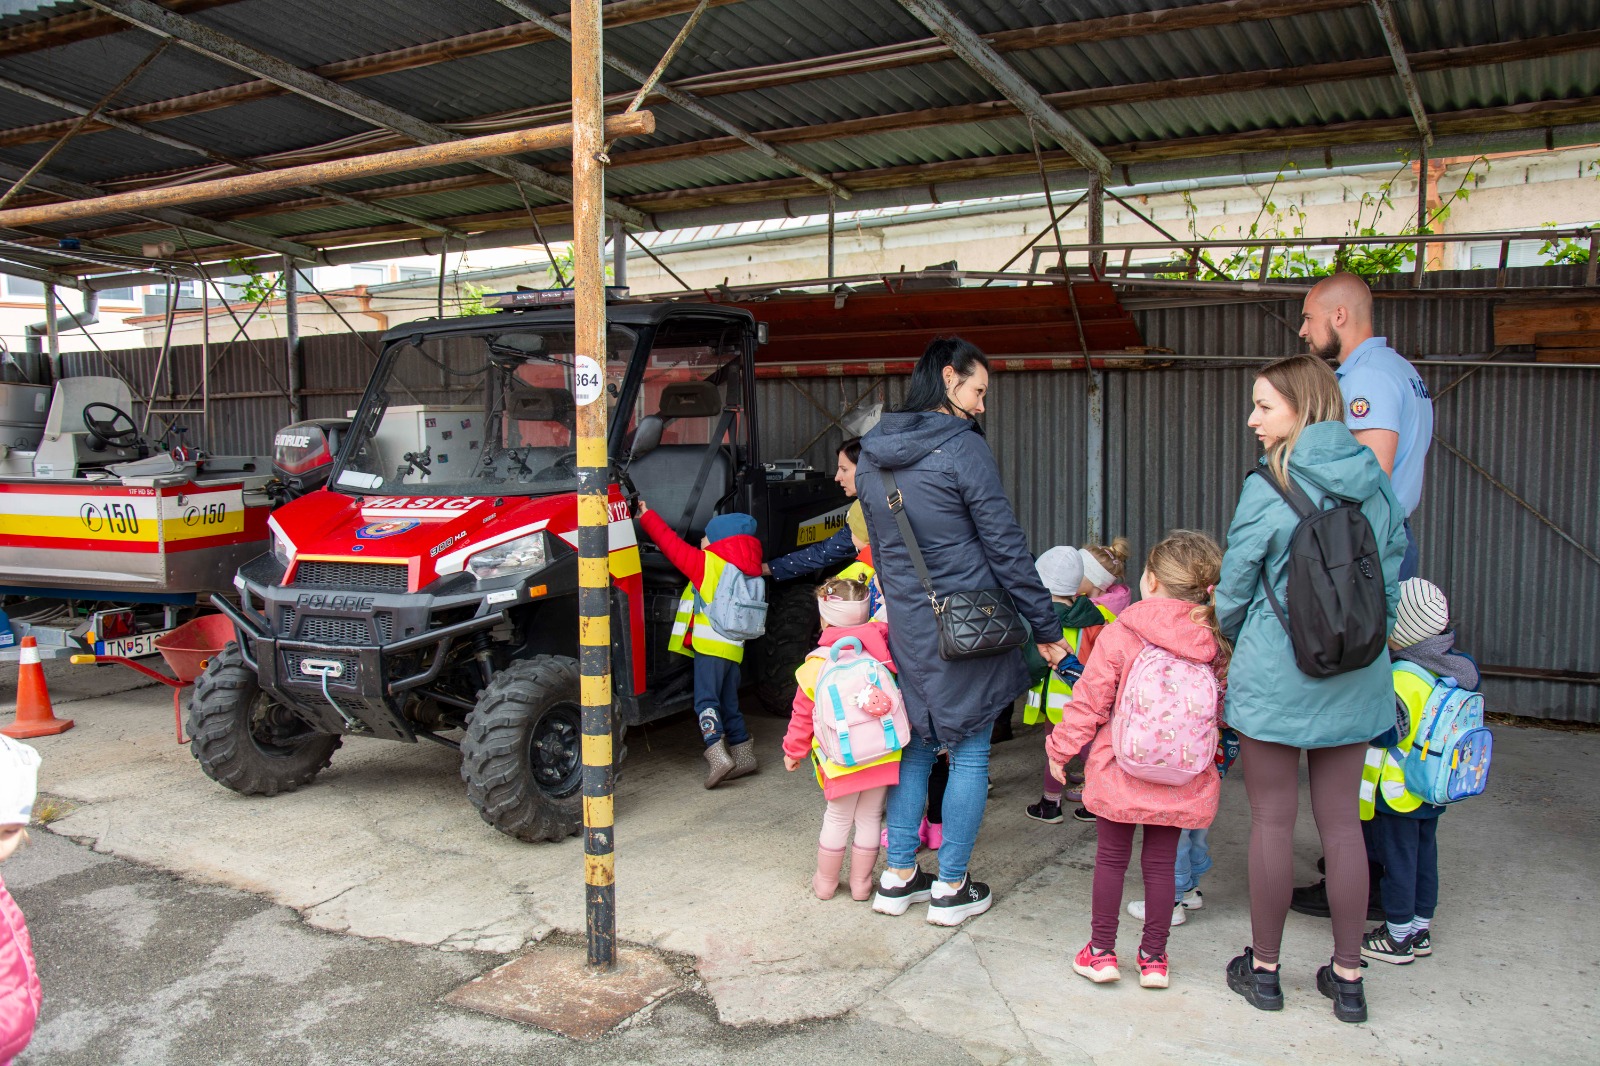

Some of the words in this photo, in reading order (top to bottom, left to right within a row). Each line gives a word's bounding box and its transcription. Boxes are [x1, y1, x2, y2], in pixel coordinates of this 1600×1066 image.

[362, 496, 485, 509] HASIČI
[614, 501, 629, 520] 112
[103, 503, 139, 534] 150
[203, 503, 226, 524] 150
[806, 526, 816, 542] 150
[297, 594, 375, 612] POLARIS
[107, 640, 127, 656] TN
